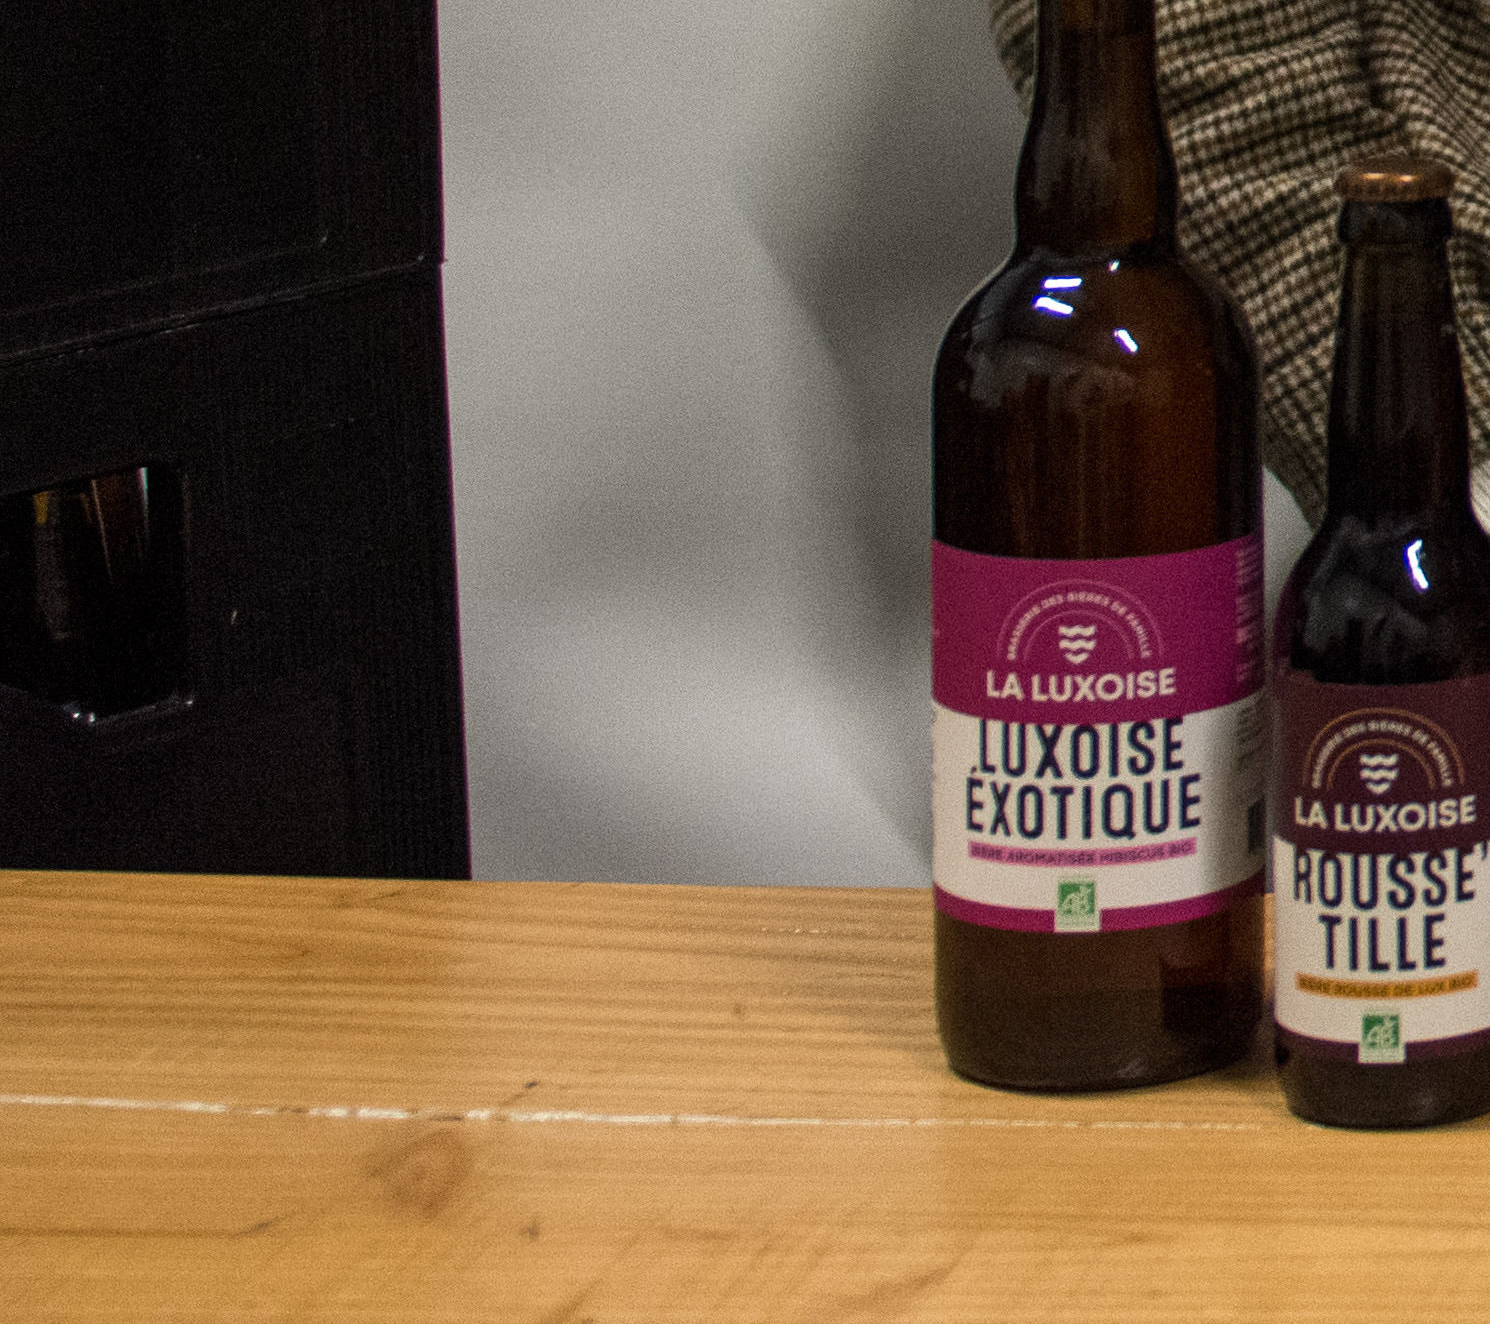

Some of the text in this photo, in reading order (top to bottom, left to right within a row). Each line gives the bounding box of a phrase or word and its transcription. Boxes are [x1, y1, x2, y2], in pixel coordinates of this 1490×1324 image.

[986, 667, 1177, 702] LA LUXOISE
[980, 717, 1184, 779] LUXOISE
[1294, 794, 1477, 832] LA LUXOISE
[1318, 913, 1447, 971] TILLE
